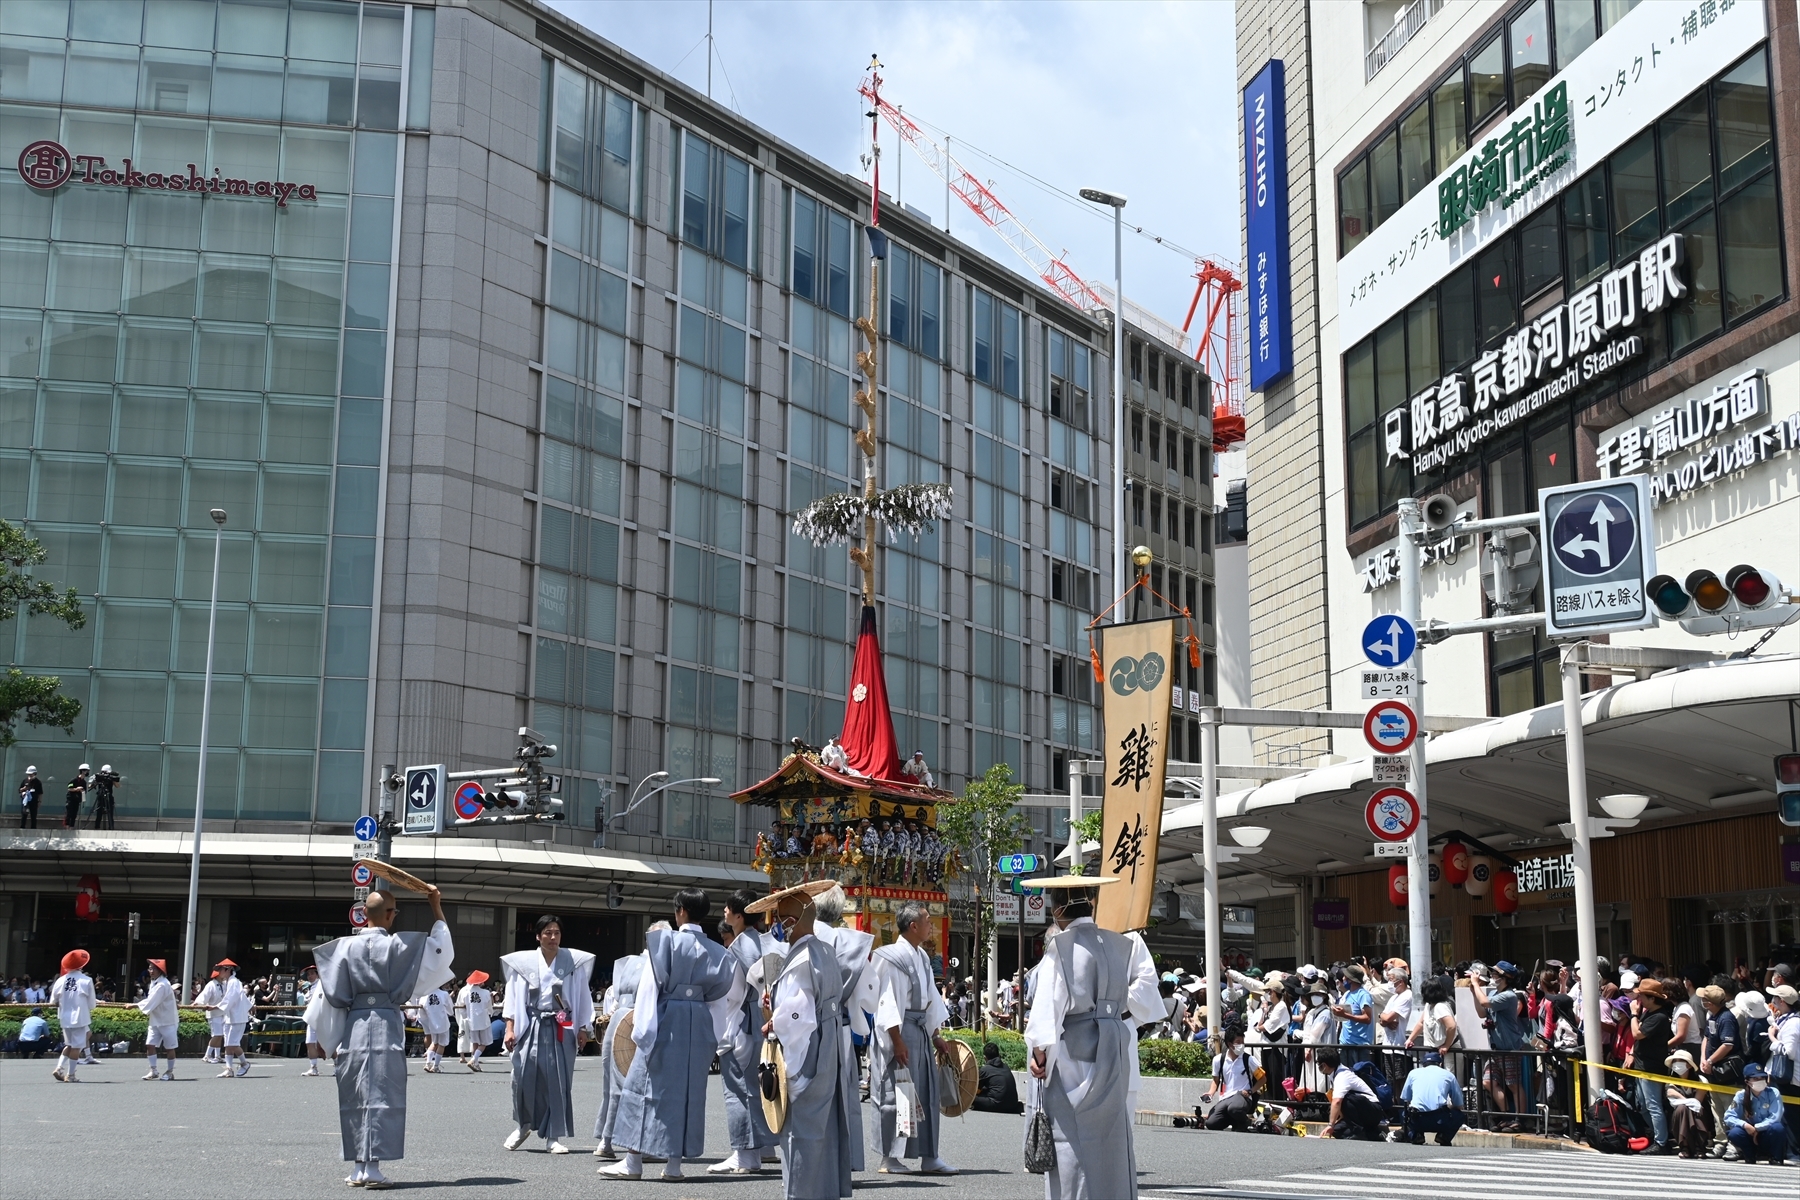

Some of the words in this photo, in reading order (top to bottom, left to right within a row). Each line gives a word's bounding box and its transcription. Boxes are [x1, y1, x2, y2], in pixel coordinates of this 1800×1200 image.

[76, 155, 318, 208] Takashimaya
[1255, 92, 1266, 208] MIZUHO
[1438, 80, 1570, 240] 眼鏡市場
[1350, 220, 1441, 307] メガネ・サングラス
[1257, 252, 1270, 363] みずほ銀行
[1413, 437, 1454, 477] Hankyu
[1456, 368, 1580, 453] Kyoto-kawaramachi
[1583, 336, 1636, 380] Station
[1596, 368, 1765, 479] 千里・嵐山方面
[1556, 587, 1641, 613] 路線バスを除く
[1363, 671, 1415, 683] 路線バスを除く
[1374, 765, 1410, 773] マイクロを除く
[1012, 858, 1022, 870] 32
